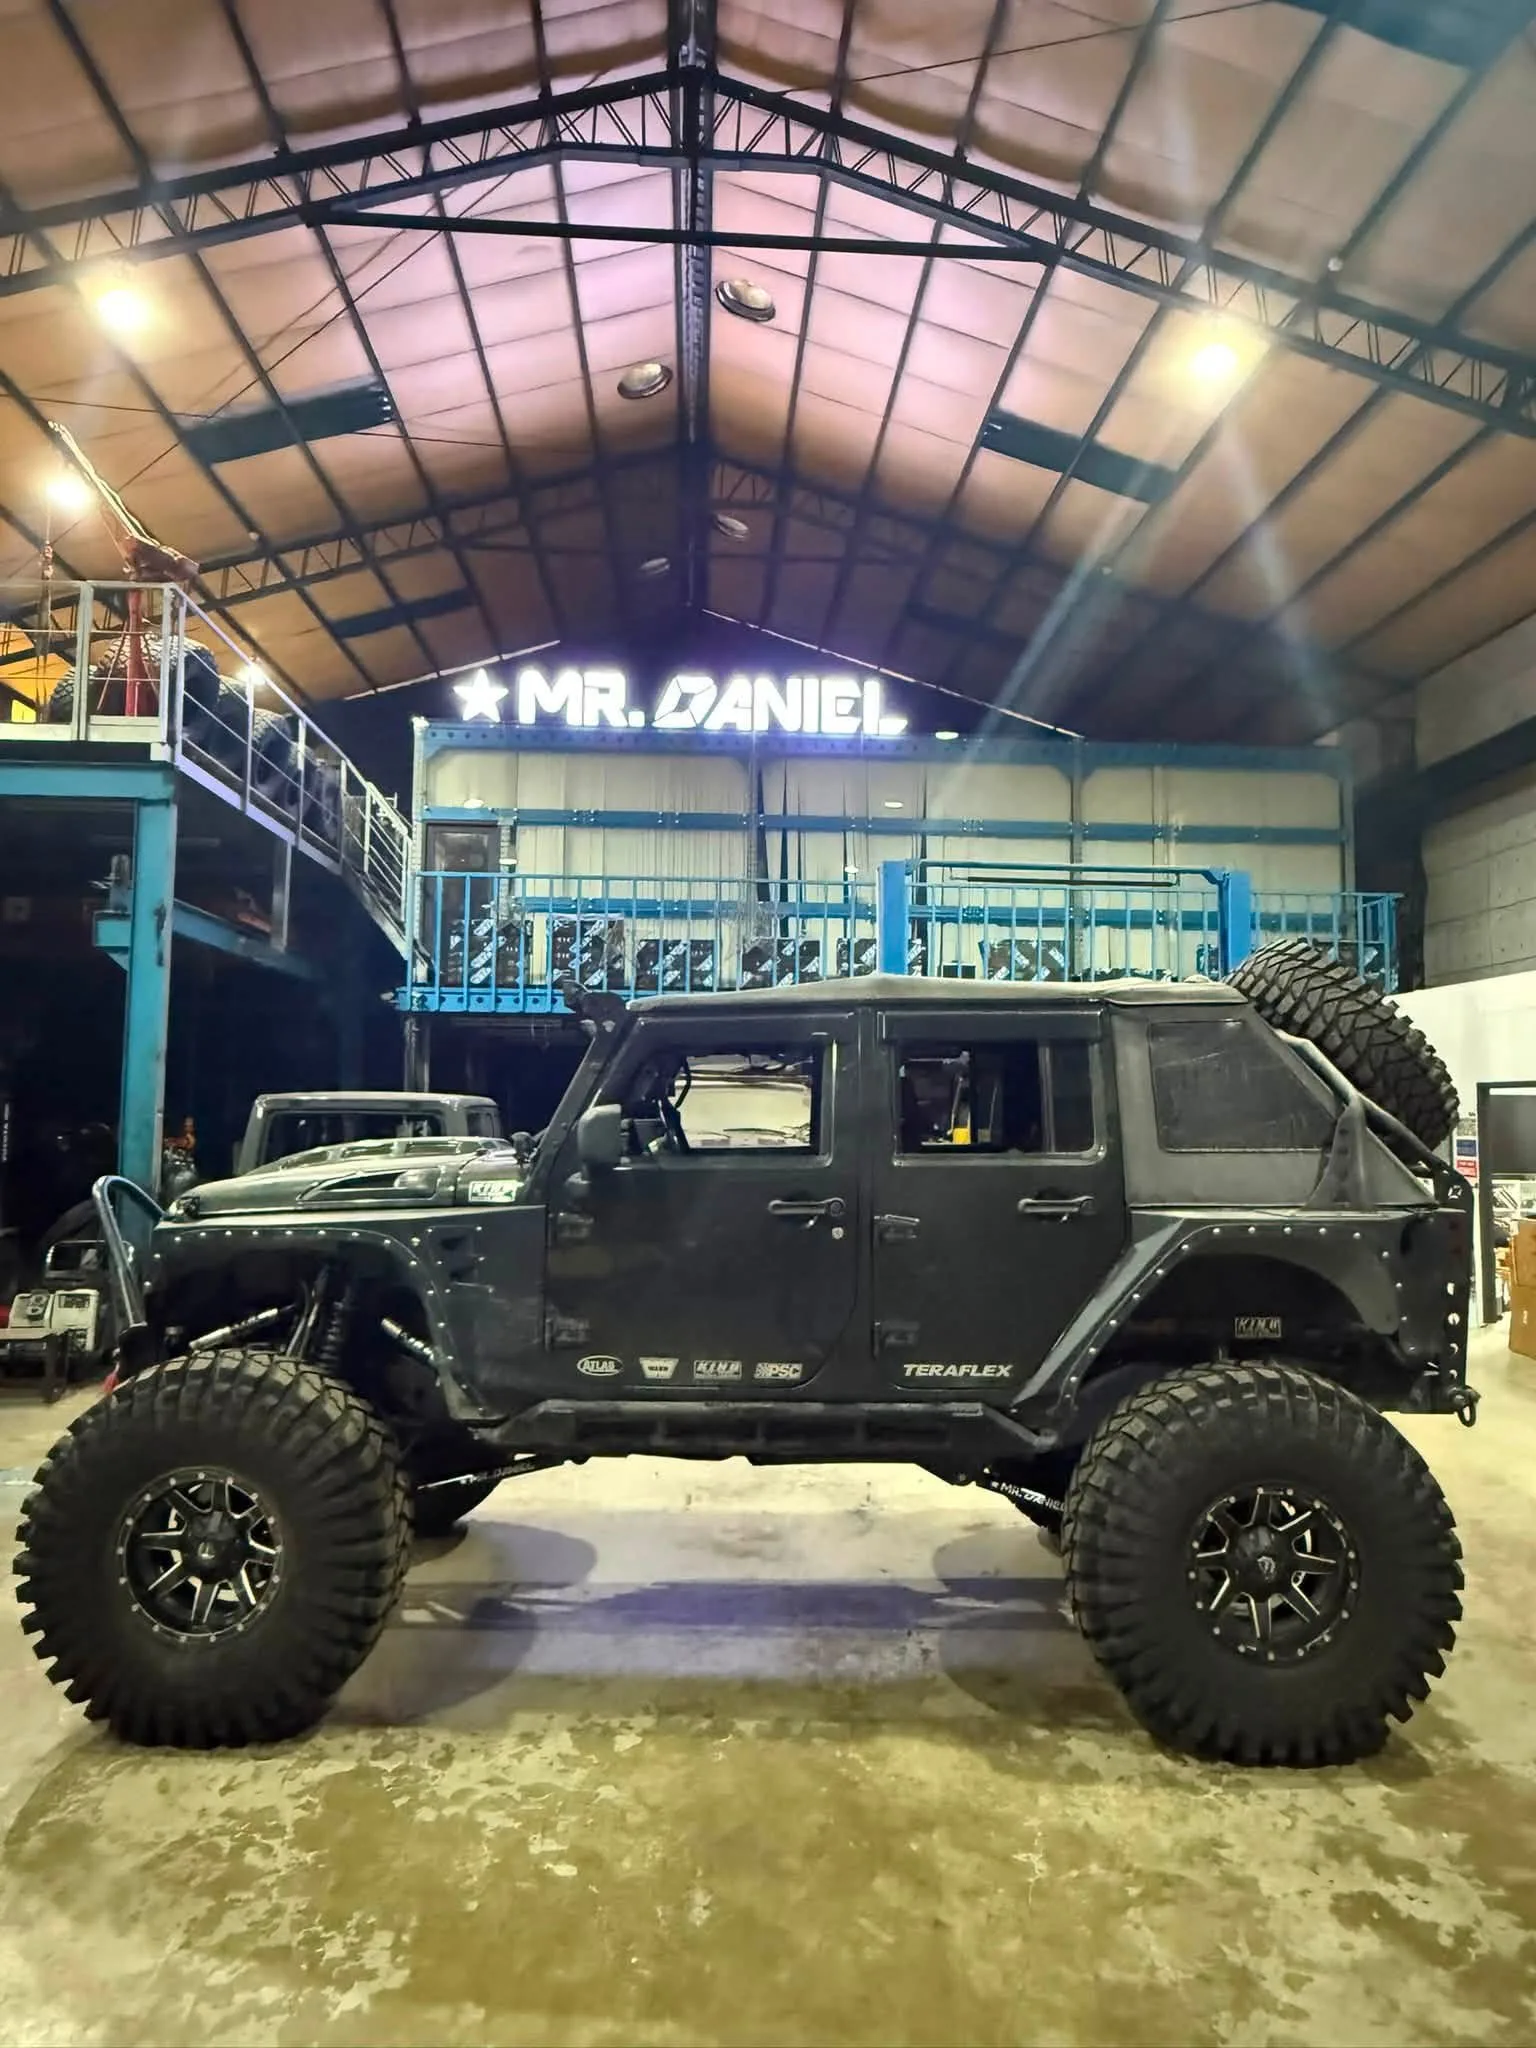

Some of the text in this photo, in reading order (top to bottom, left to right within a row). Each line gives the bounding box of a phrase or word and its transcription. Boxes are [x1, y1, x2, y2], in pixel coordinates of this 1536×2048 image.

[518, 669, 908, 735] MR. DANIEL
[903, 1364, 1013, 1377] TERAFLEX
